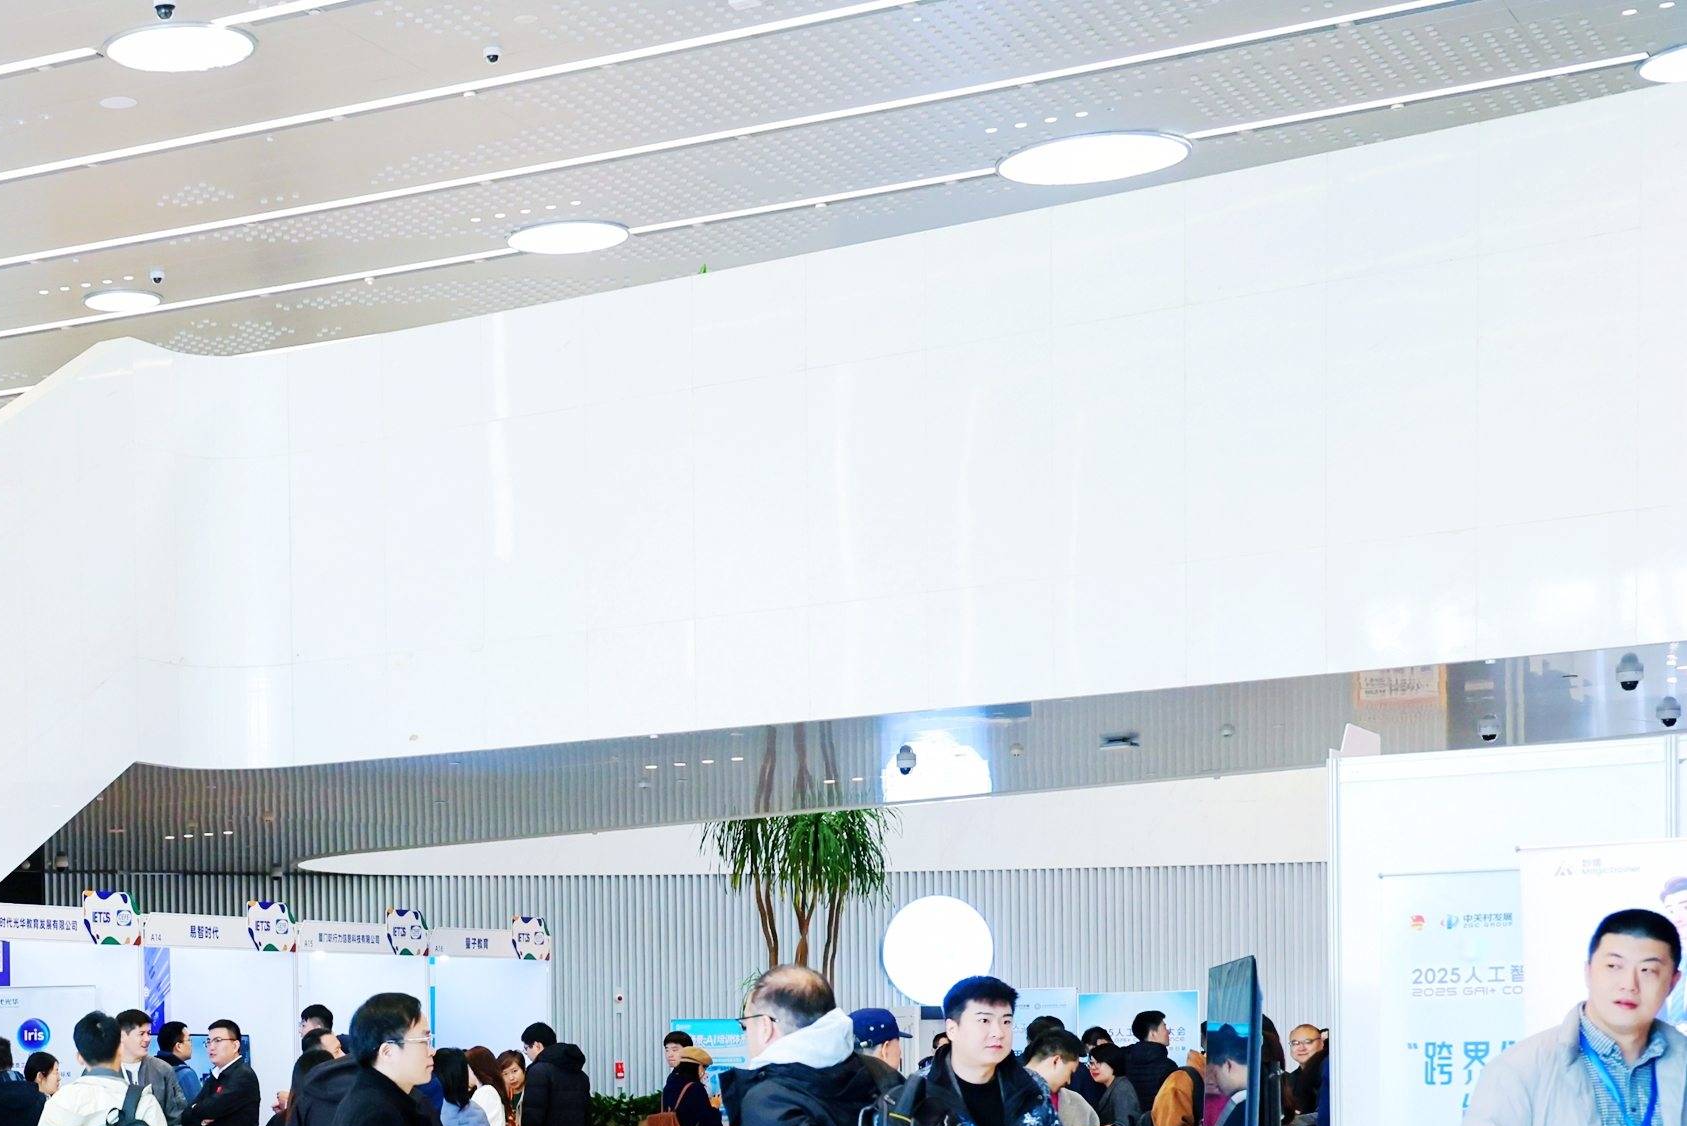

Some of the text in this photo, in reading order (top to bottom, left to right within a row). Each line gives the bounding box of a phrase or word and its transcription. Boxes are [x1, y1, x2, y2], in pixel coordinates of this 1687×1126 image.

[150, 933, 162, 942] A14
[190, 925, 220, 940] 易智时代
[24, 1028, 44, 1041] Iris
[1408, 1040, 1516, 1085] “跨界
